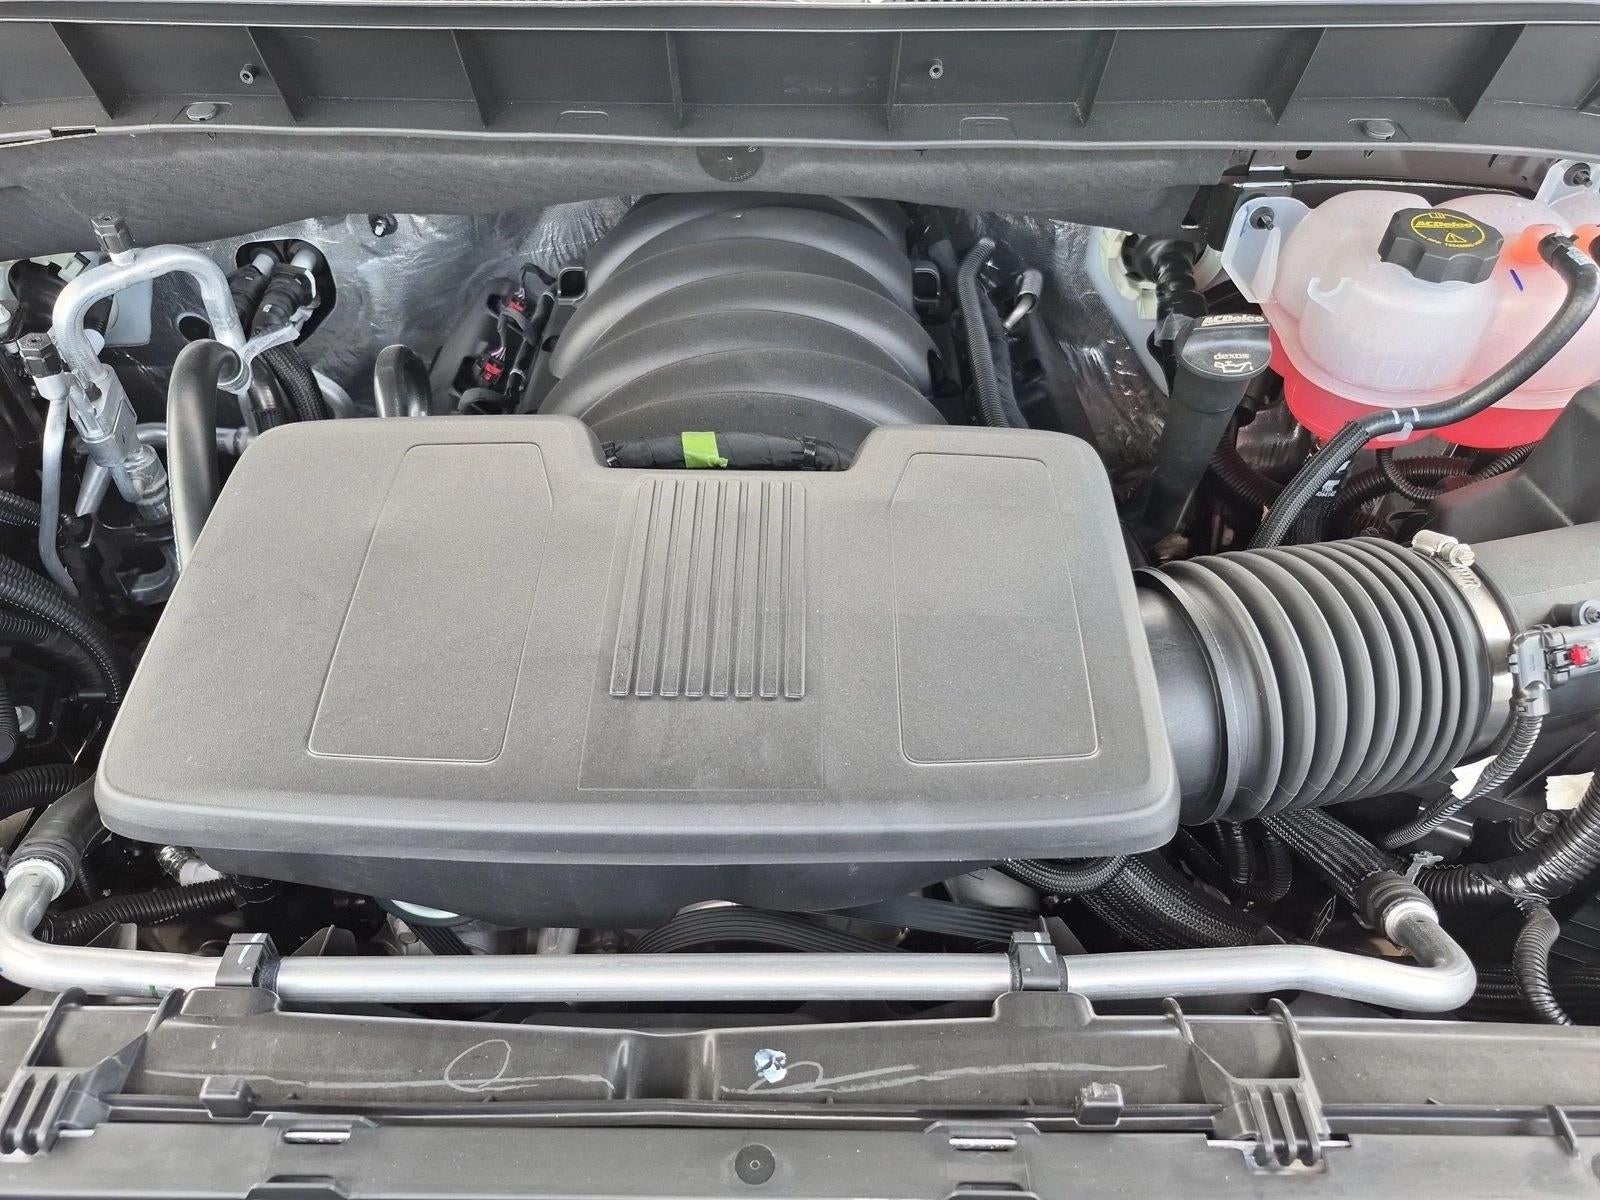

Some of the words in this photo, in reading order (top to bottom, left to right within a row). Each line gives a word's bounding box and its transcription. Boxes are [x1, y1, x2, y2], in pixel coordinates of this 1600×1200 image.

[1414, 220, 1475, 229] ACDelco
[1201, 314, 1265, 327] ACDelco
[1213, 352, 1250, 361] dexos
